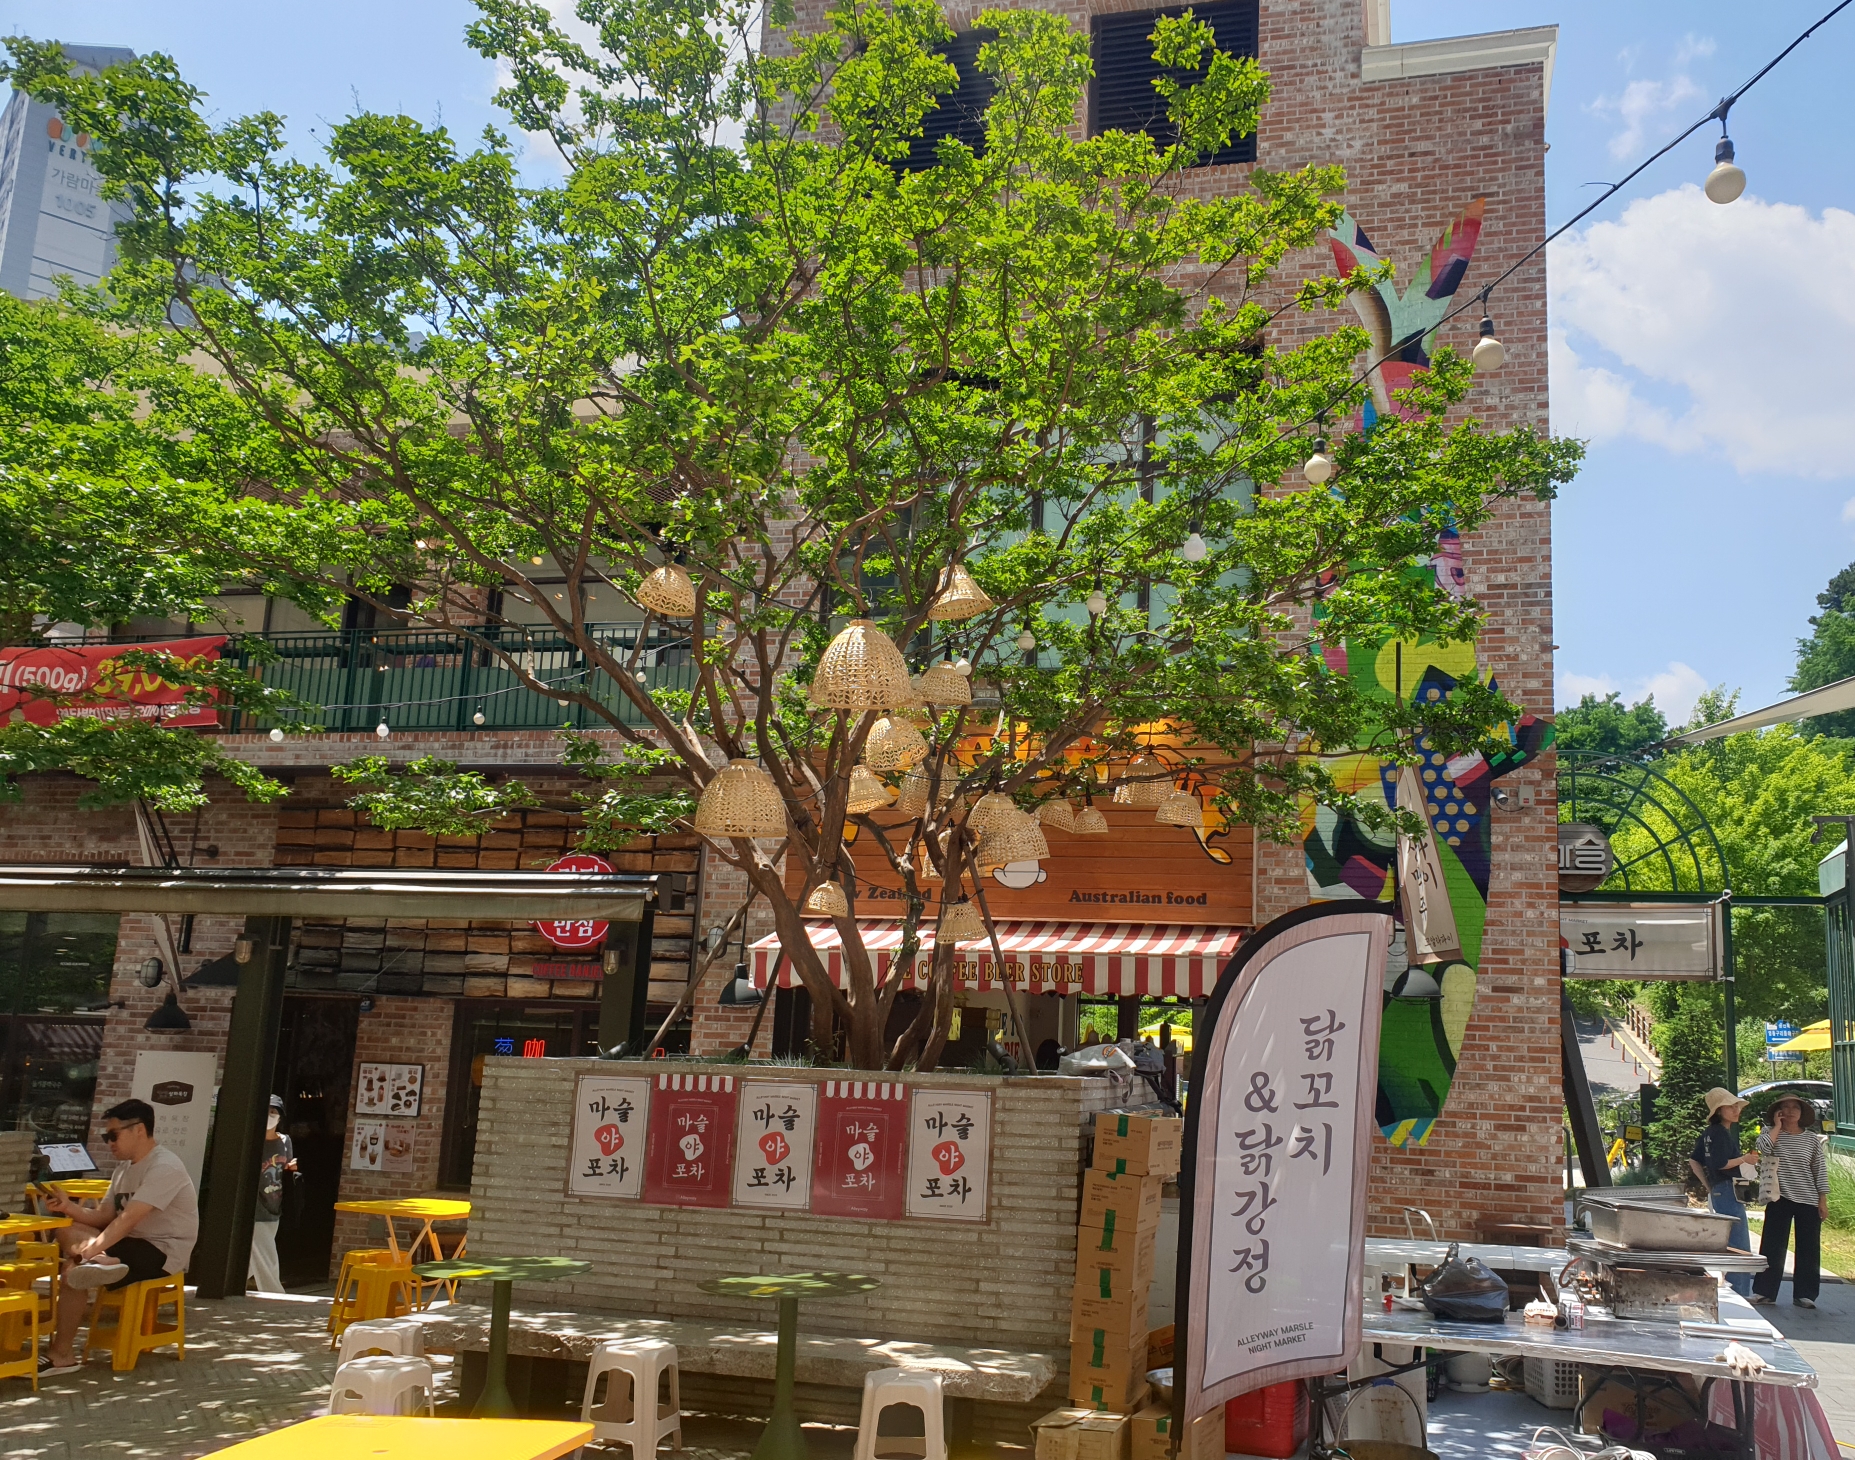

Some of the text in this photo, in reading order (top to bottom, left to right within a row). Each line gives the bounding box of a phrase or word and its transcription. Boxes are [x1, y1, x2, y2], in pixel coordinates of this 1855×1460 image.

[48, 140, 87, 163] VERT
[52, 168, 101, 194] 가람마
[868, 886, 932, 900] Zeald
[1068, 889, 1207, 906] Australian food
[1575, 928, 1644, 961] 포차
[533, 963, 567, 977] COFFEE
[918, 960, 978, 981] CFEE
[984, 962, 1025, 982] BEER
[1031, 962, 1083, 983] STORE
[1289, 1009, 1346, 1177] 닭꼬치
[588, 1095, 635, 1123] 마슬
[752, 1102, 801, 1131] 마슬
[677, 1113, 709, 1133] 마슬
[846, 1121, 879, 1142] 마슬
[924, 1110, 974, 1140] 마슬
[601, 1127, 619, 1151] 야
[685, 1138, 700, 1156] 야
[766, 1136, 785, 1159] 야
[854, 1147, 870, 1166] 야
[939, 1144, 959, 1170] 야
[582, 1156, 630, 1183] 포차
[672, 1162, 705, 1181] 포차
[746, 1166, 797, 1193] 포차
[842, 1172, 876, 1191] 포차
[920, 1175, 972, 1204] 포차
[1228, 1071, 1283, 1294] & 닭강정
[1237, 1321, 1314, 1347] ALLEYWAY MARSLE
[1248, 1333, 1307, 1355] NIGHT MARKET
